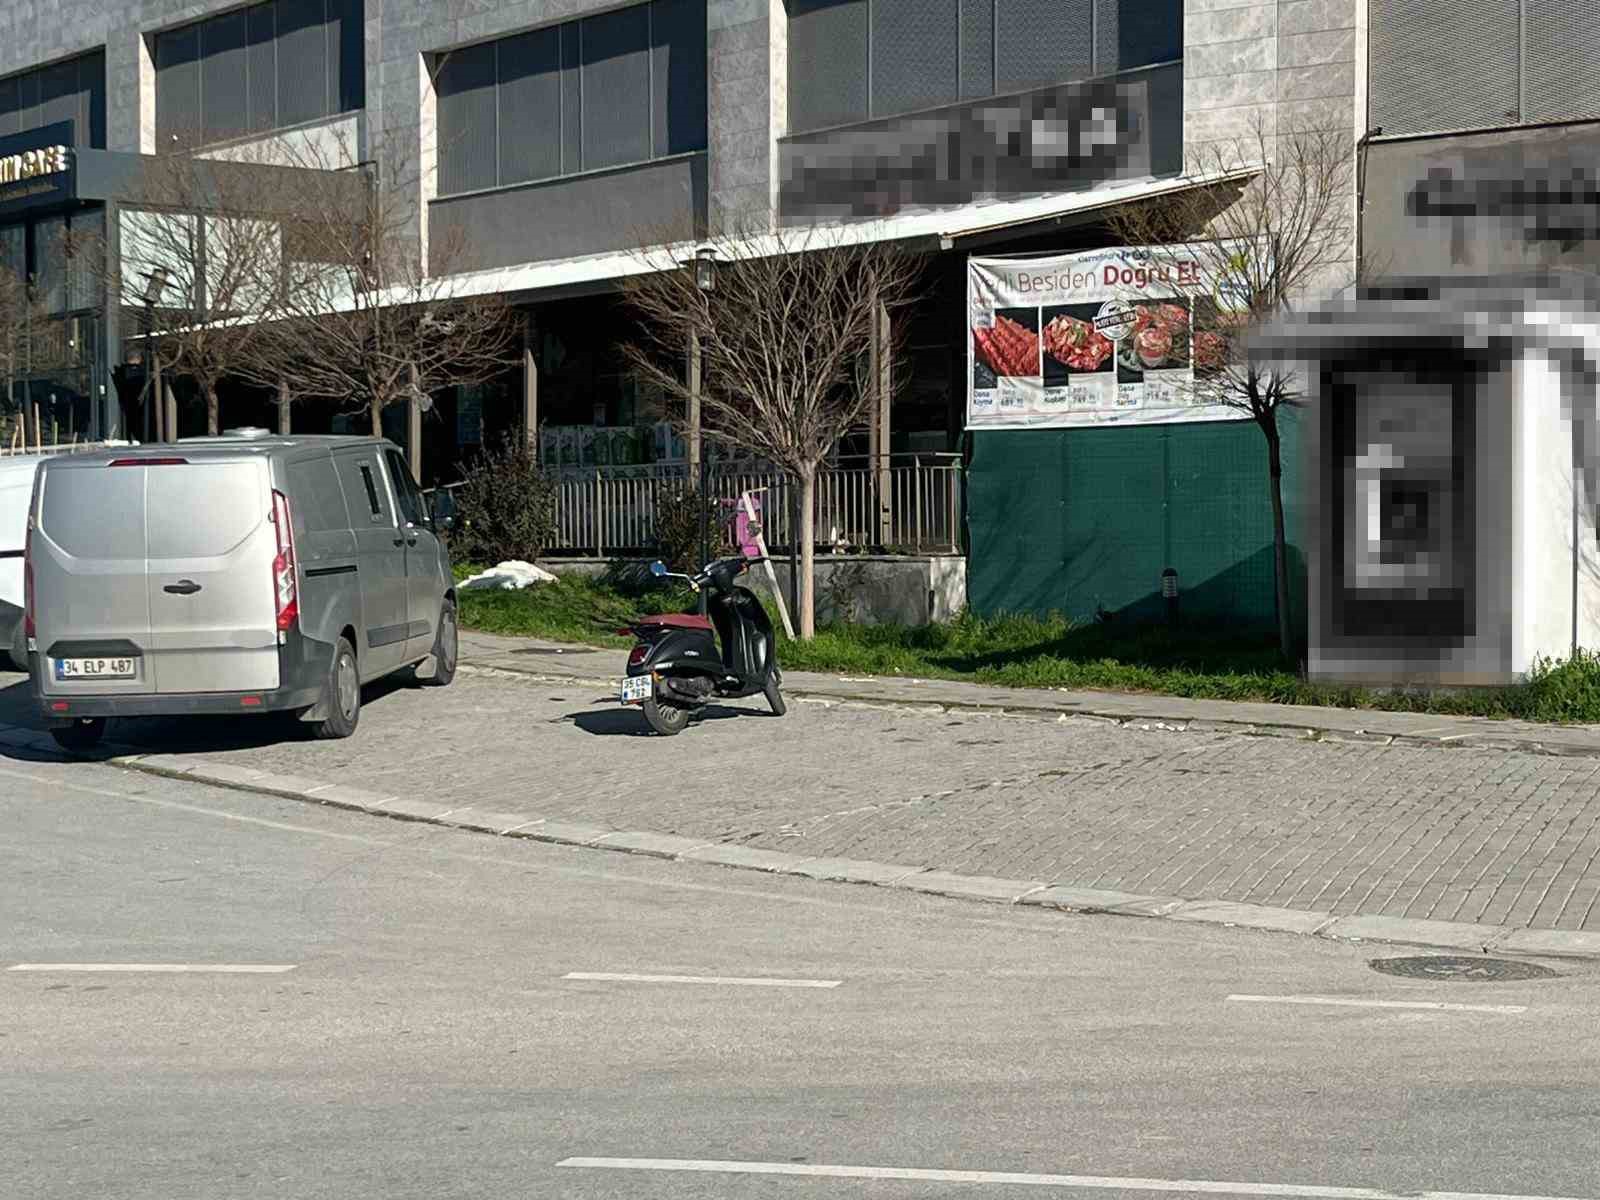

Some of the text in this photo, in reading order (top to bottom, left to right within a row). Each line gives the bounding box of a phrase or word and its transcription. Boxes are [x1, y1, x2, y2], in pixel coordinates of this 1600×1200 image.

[1017, 267, 1096, 293] Besiden
[1103, 262, 1170, 289] Doğru
[1177, 260, 1201, 282] Et
[64, 660, 131, 673] 34 ELP 487
